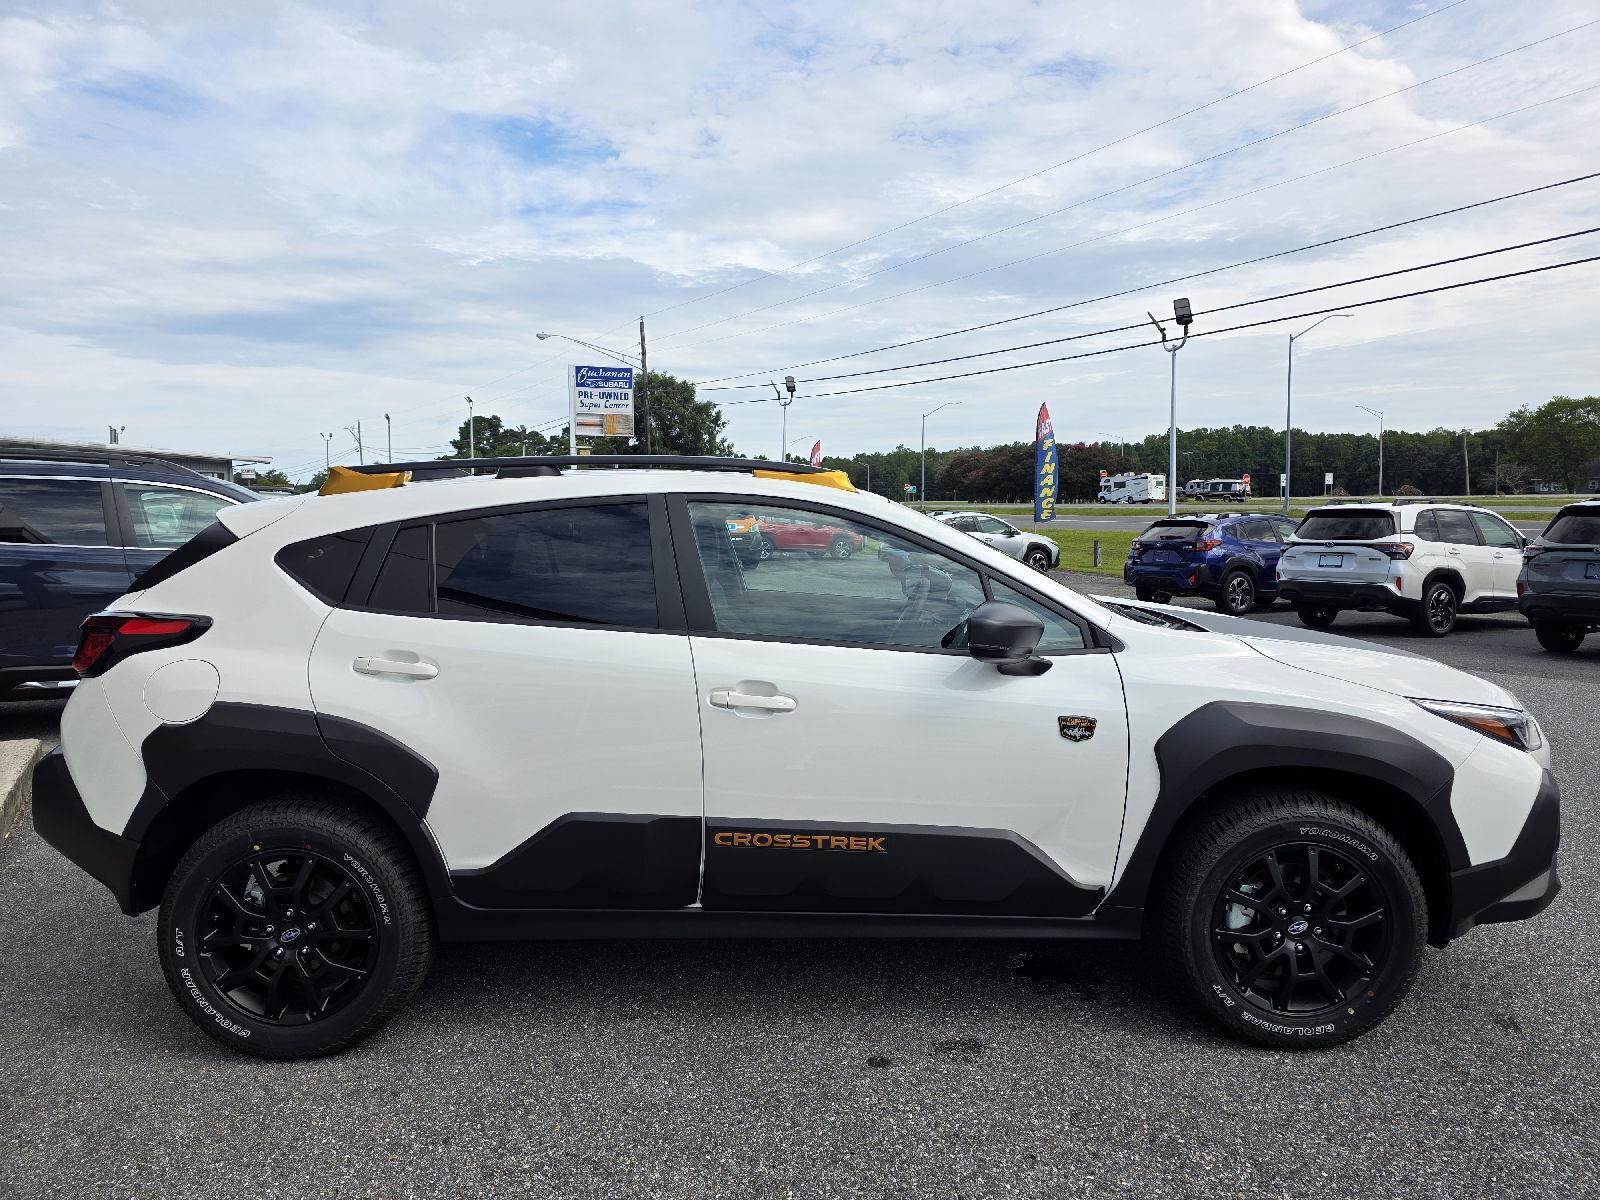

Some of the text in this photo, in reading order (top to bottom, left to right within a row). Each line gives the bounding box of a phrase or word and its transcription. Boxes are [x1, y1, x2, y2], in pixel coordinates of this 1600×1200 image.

[577, 367, 631, 384] Buchanan
[598, 380, 629, 388] SUBARU
[578, 391, 629, 401] PRE-OWNED
[579, 400, 630, 411] Super Center
[1039, 438, 1056, 520] FINANCE
[714, 832, 887, 851] CROSSTREK
[1299, 827, 1379, 861] YOKOHAMA
[1241, 1011, 1335, 1036] GEOLANDAR
